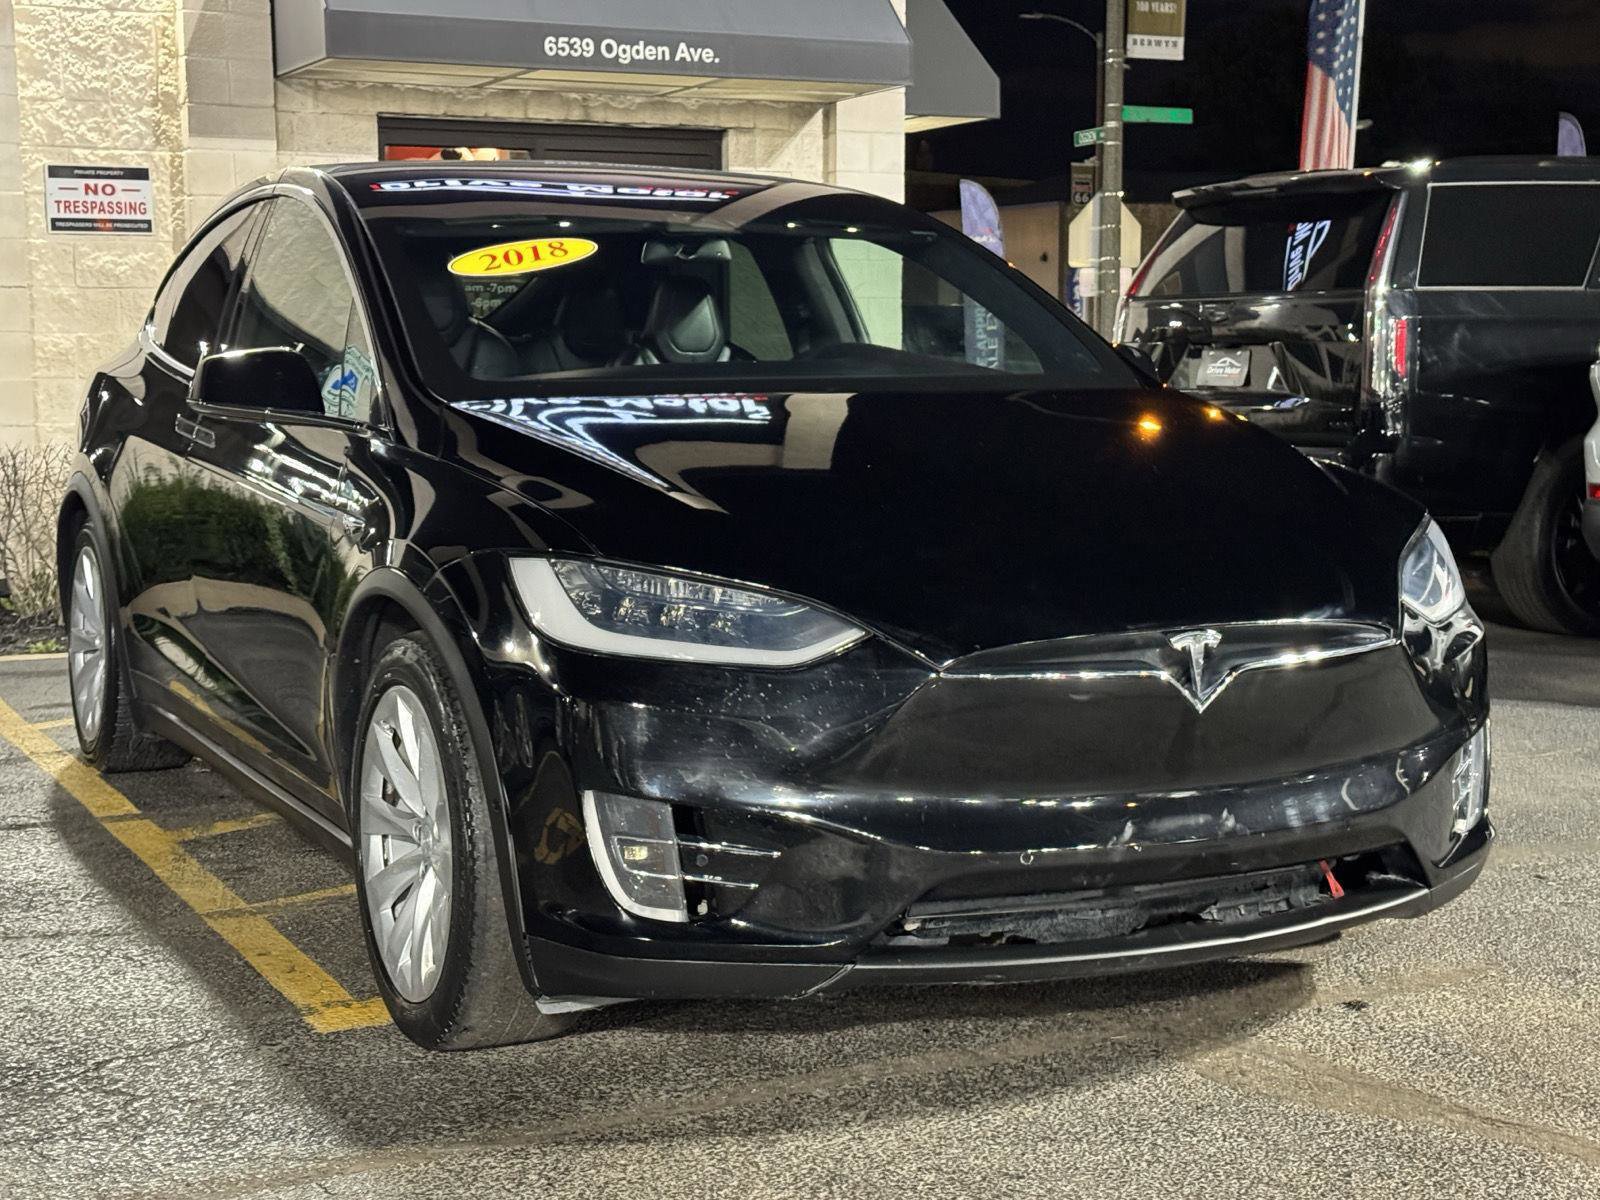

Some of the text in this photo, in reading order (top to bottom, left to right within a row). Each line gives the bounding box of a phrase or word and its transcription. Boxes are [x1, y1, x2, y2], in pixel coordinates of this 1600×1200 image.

[1131, 37, 1179, 48] BERWYN
[543, 35, 721, 65] 6539 Ogden Ave.
[84, 183, 116, 196] NO
[1073, 192, 1090, 203] 66
[54, 200, 147, 215] TRESPASSING
[478, 240, 570, 272] 2018
